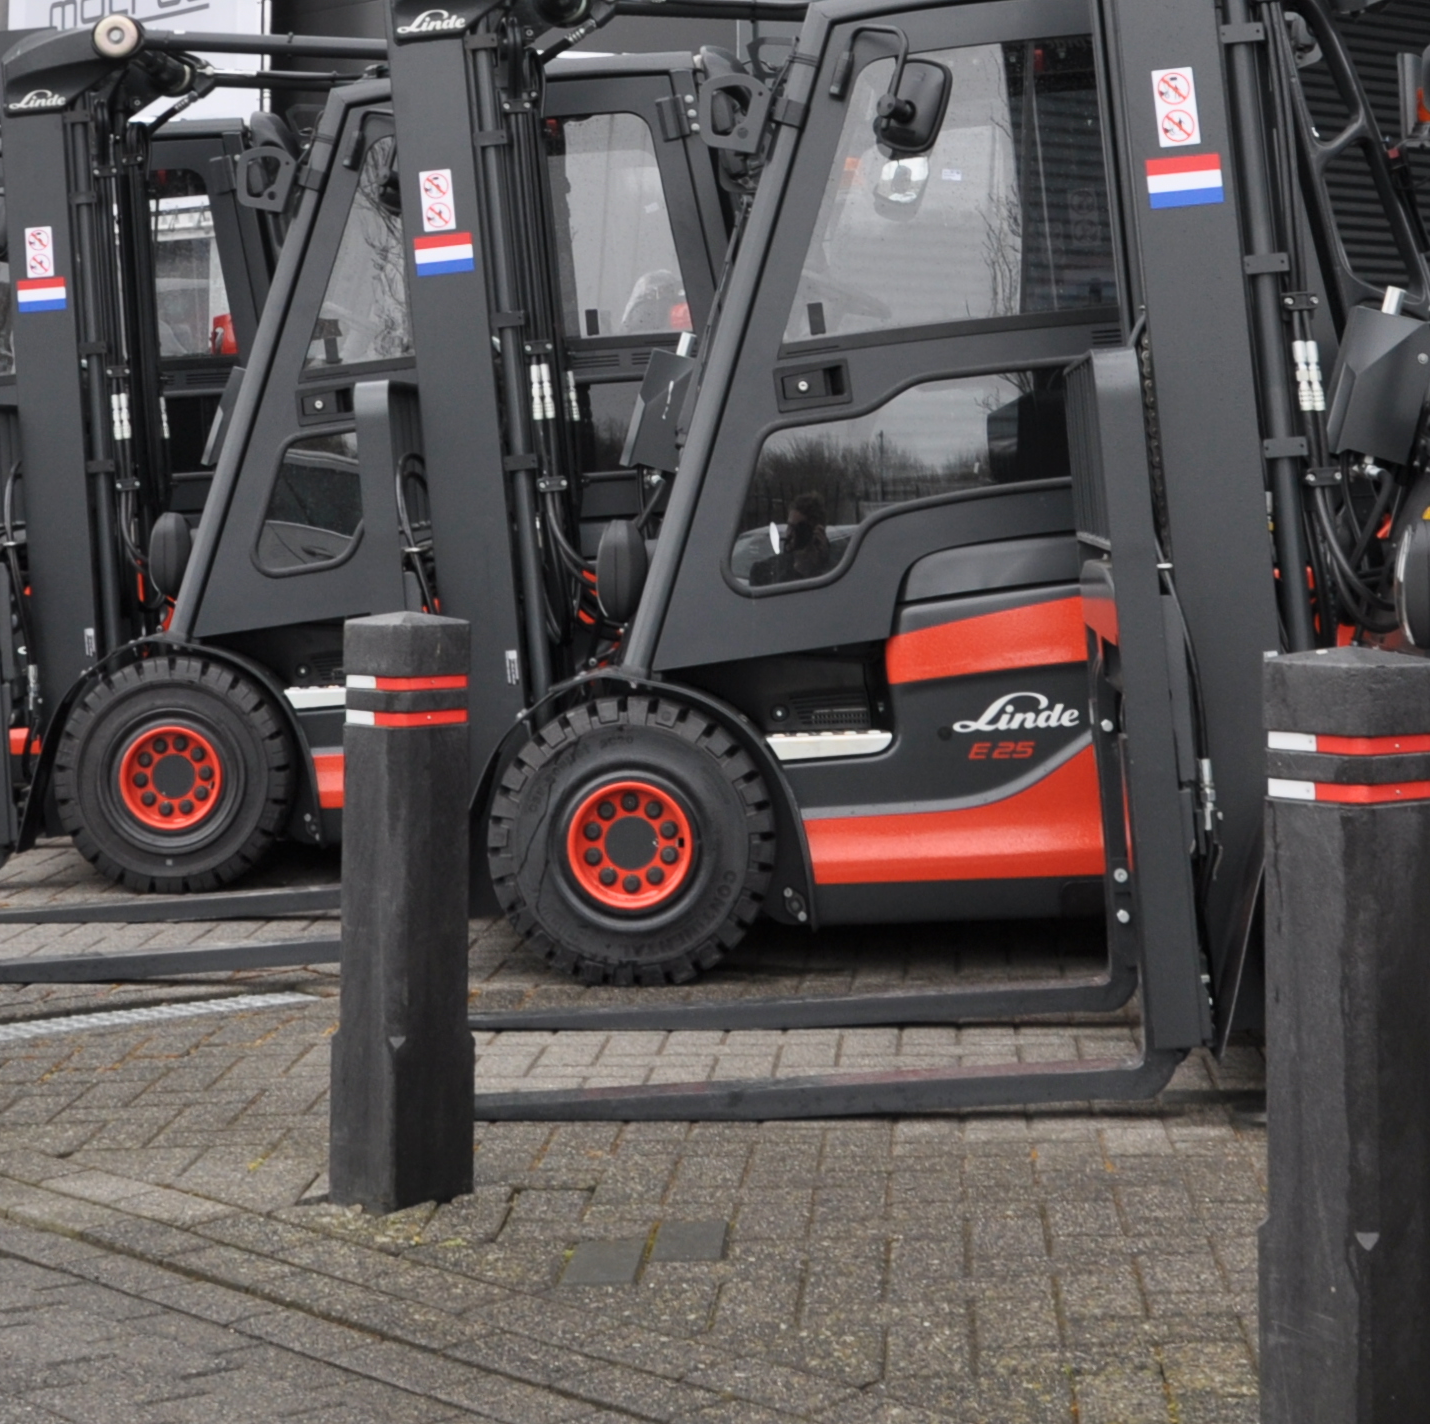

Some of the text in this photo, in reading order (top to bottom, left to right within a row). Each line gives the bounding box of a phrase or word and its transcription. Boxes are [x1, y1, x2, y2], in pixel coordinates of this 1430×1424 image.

[396, 9, 466, 34] Linde
[8, 89, 66, 110] Linde
[952, 691, 1080, 733] Linde
[968, 740, 1036, 761] E 25
